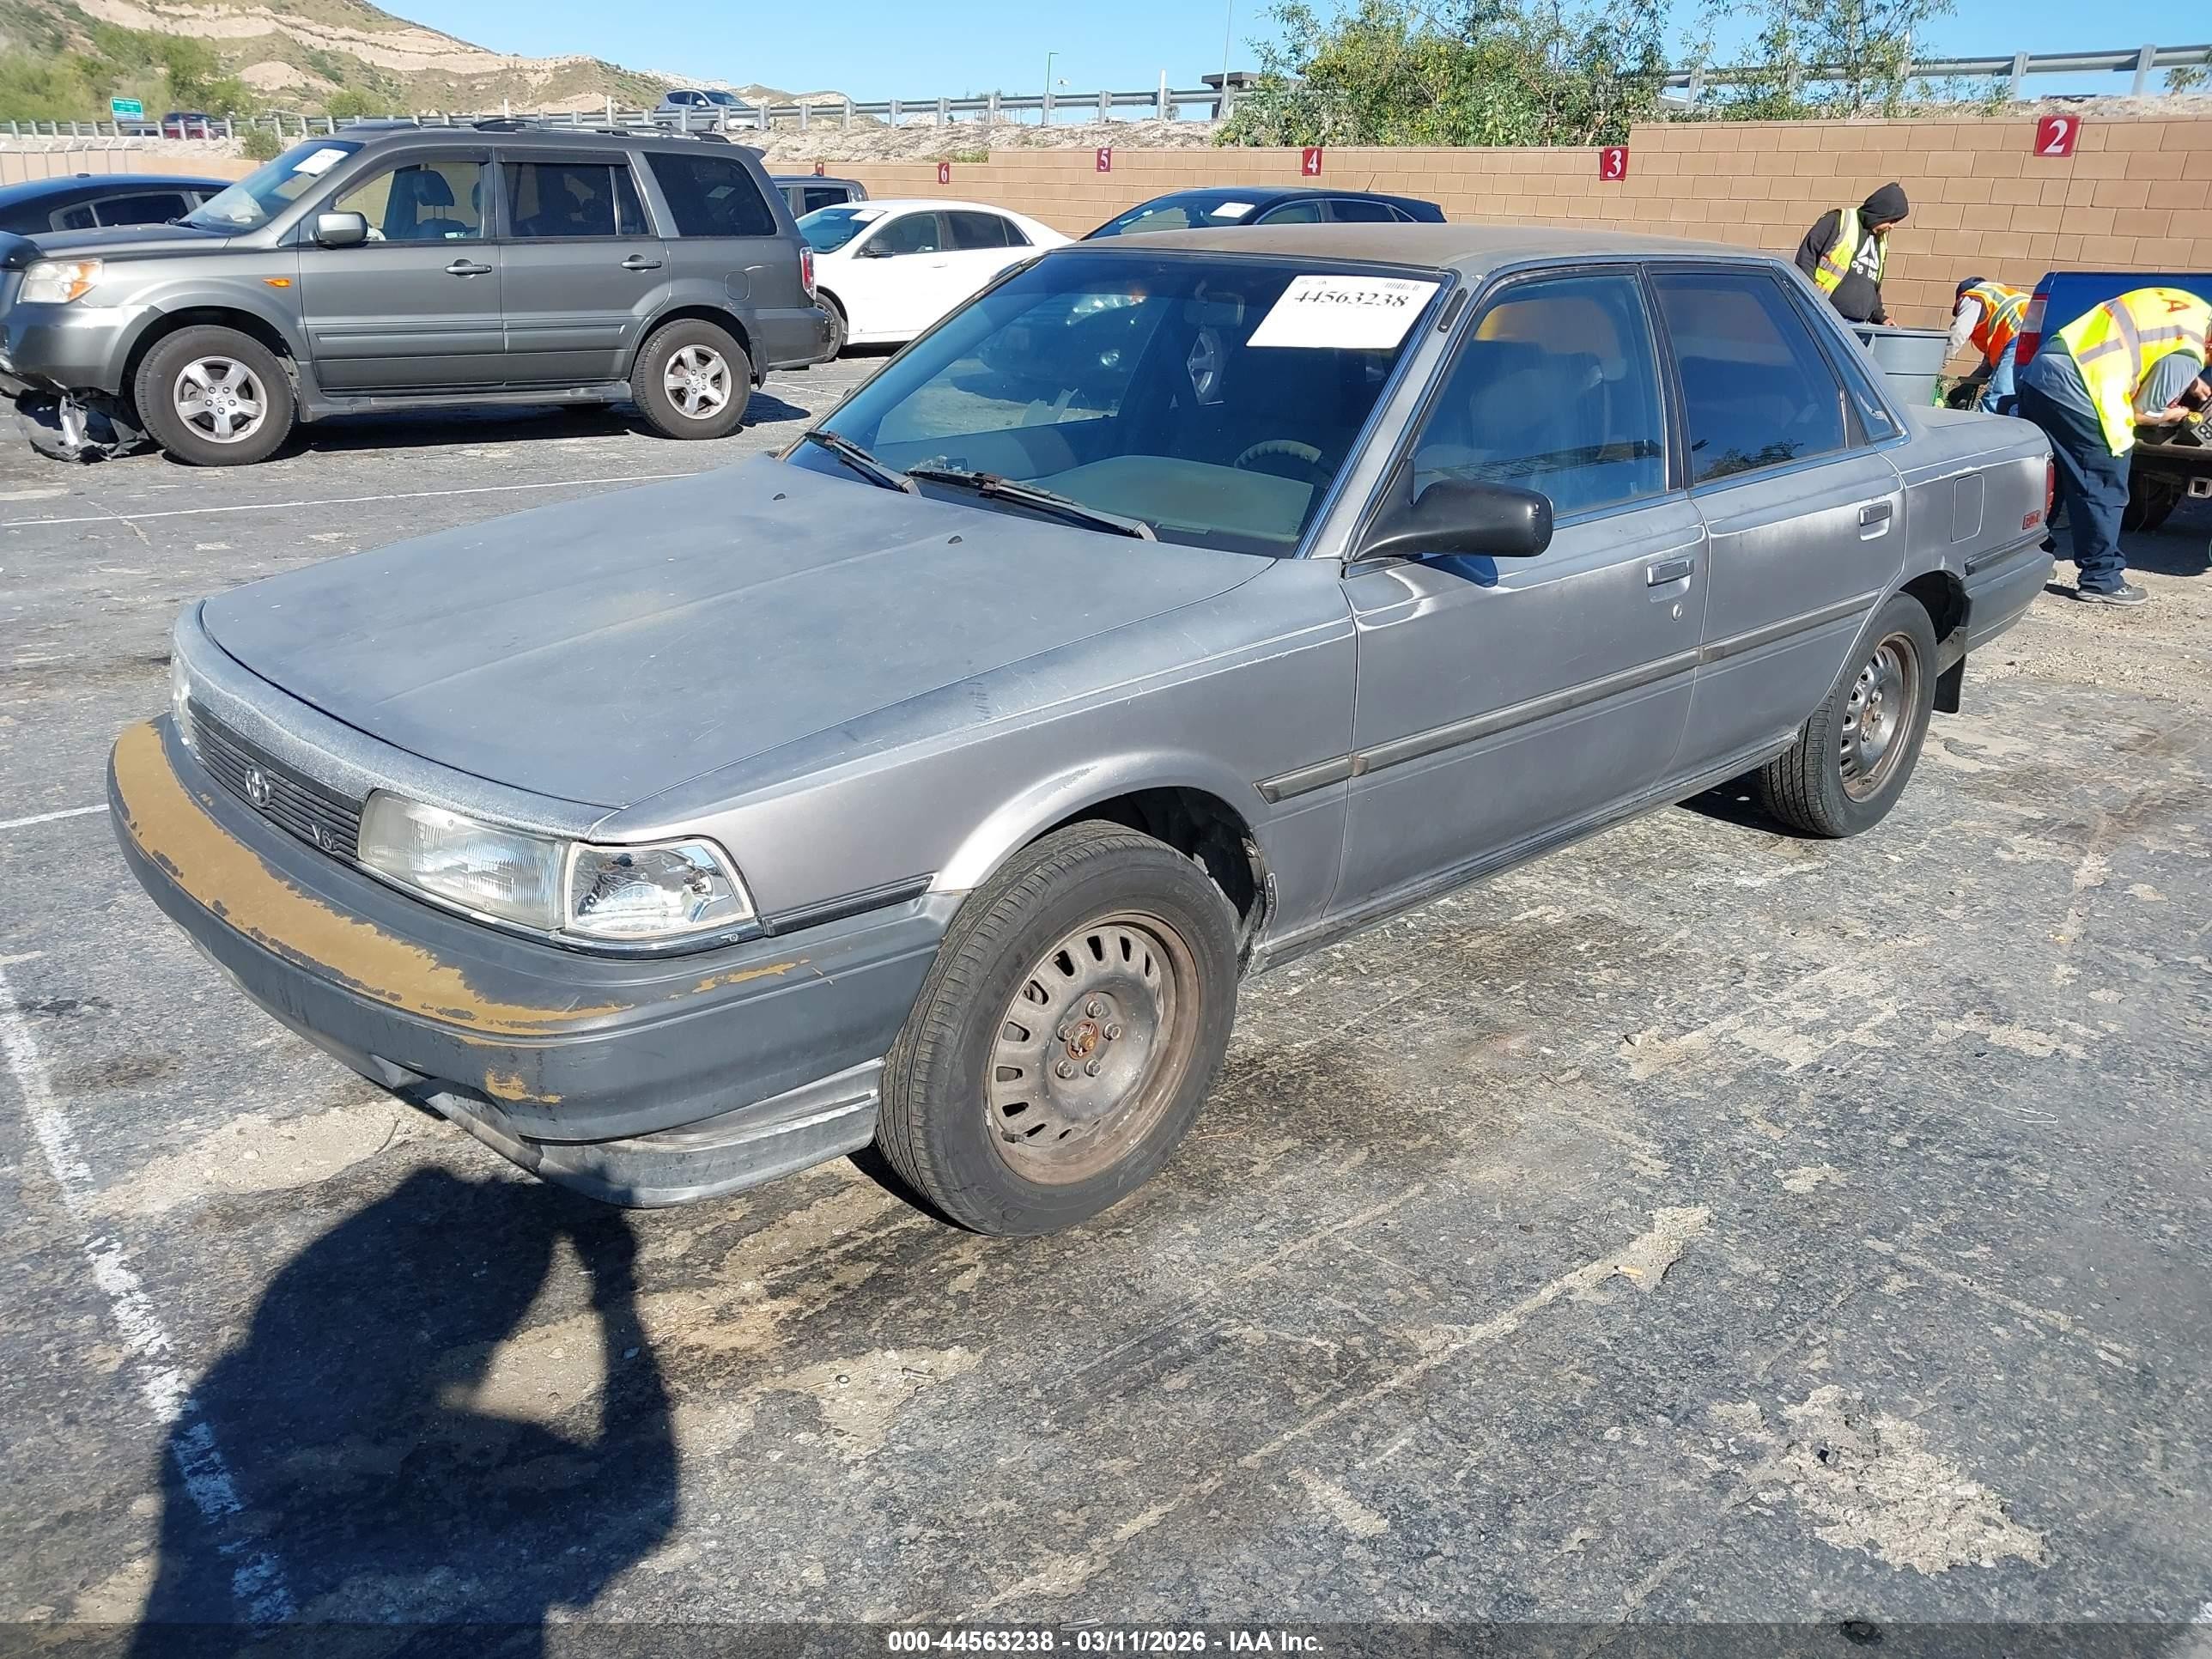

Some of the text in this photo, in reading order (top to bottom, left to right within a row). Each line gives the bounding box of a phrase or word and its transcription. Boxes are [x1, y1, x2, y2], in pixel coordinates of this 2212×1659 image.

[2043, 119, 2068, 153] 2
[1100, 149, 1109, 170] 5
[1307, 149, 1318, 173] 4
[1607, 149, 1622, 178] 3
[940, 164, 948, 182] 6
[1294, 290, 1408, 307] 44563238
[312, 823, 333, 849] V6
